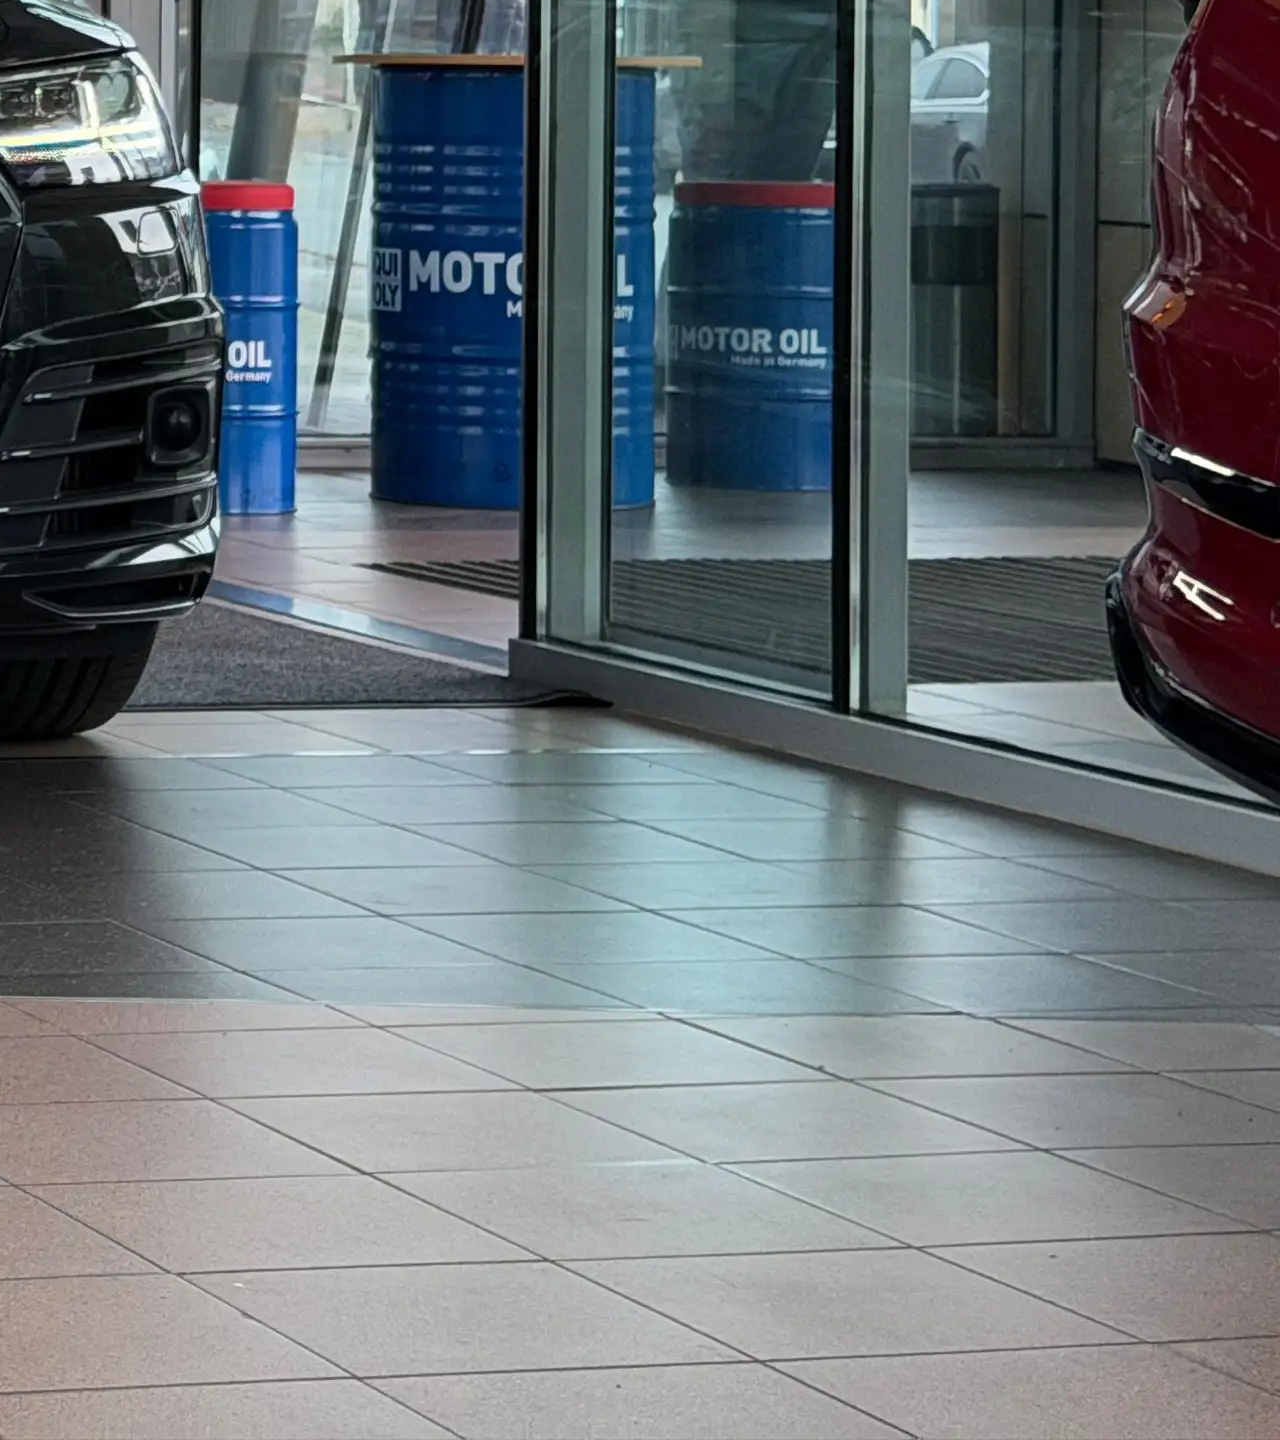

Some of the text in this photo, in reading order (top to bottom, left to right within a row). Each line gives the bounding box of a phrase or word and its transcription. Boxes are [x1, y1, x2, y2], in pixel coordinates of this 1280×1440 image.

[408, 249, 523, 296] MOTO
[227, 339, 273, 369] OIL
[680, 325, 773, 354] MOTOR
[779, 328, 828, 355] OIL
[225, 369, 272, 384] Germany
[777, 356, 827, 370] Germany
